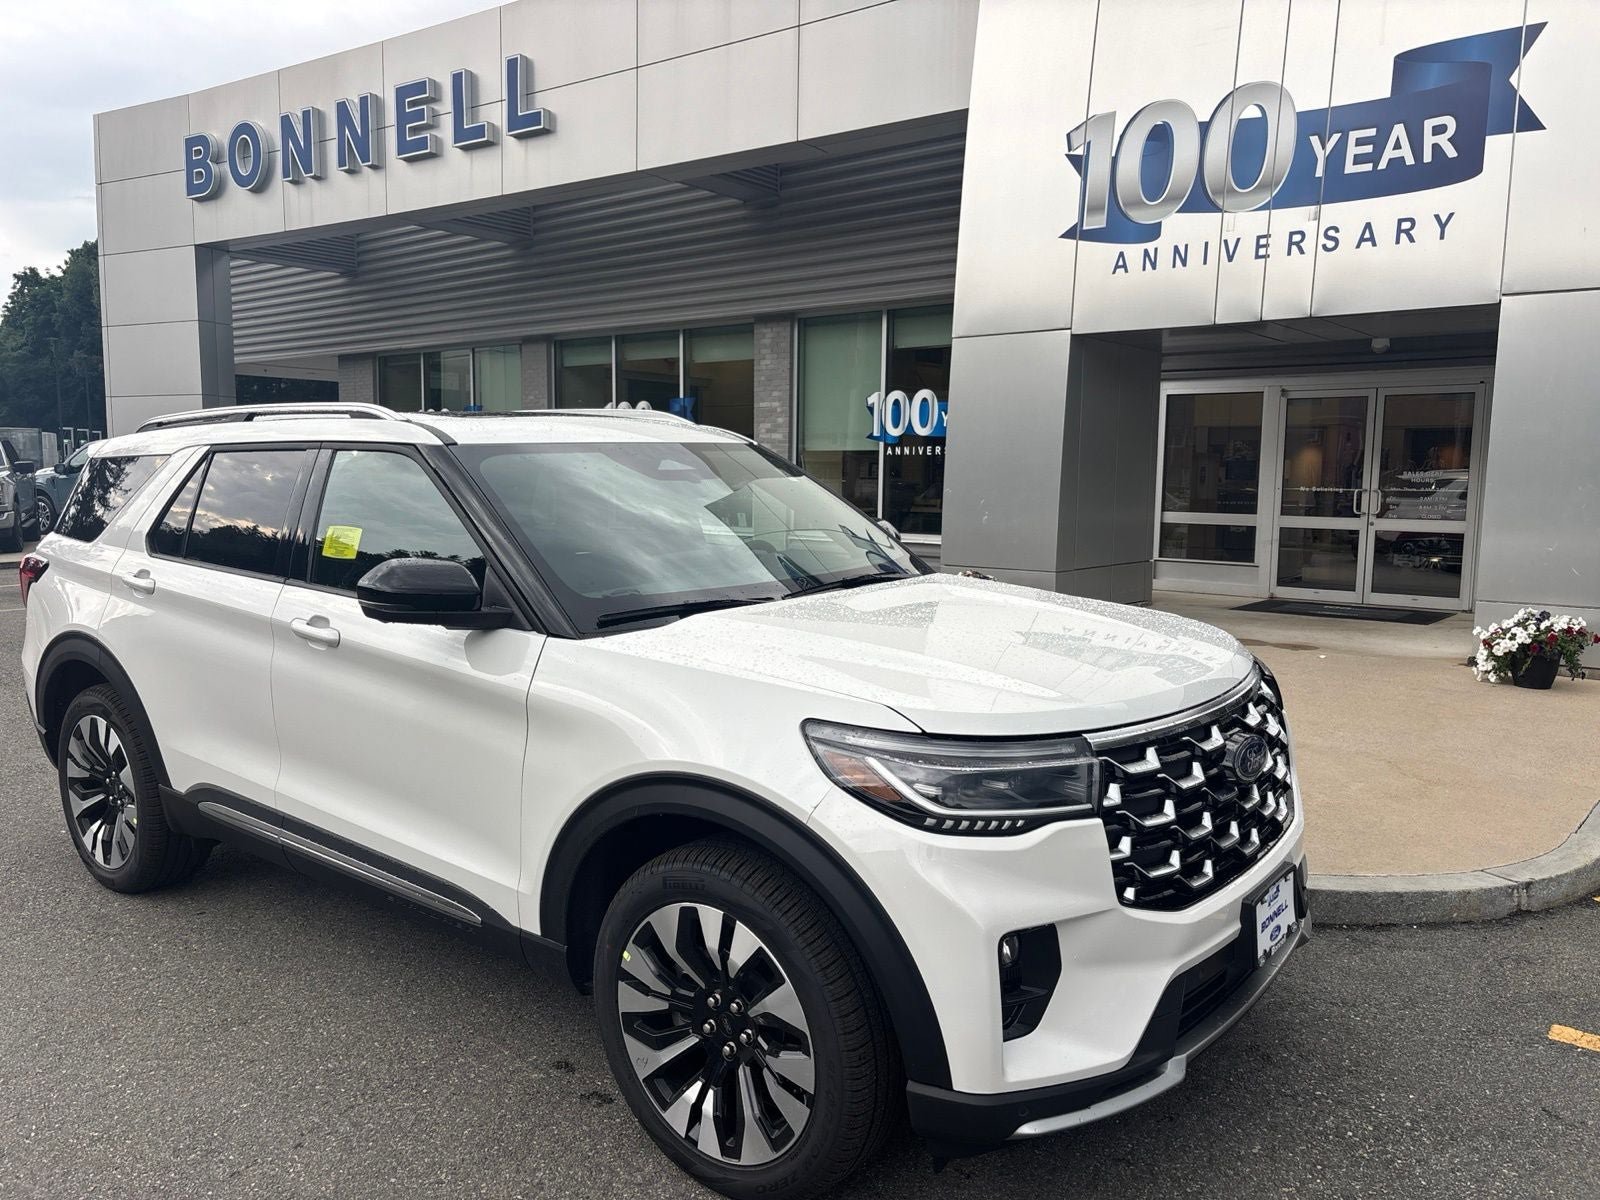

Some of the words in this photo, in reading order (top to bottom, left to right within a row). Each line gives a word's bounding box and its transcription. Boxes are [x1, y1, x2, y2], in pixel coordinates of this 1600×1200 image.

[183, 53, 550, 201] BONNELL
[1066, 80, 1297, 231] 100
[1309, 114, 1459, 178] YEAR
[1111, 211, 1456, 275] ANNIVERSARY
[866, 388, 939, 437] 100
[886, 445, 946, 456] ANNIVER
[1261, 900, 1289, 934] BONNELL
[754, 1171, 800, 1195] ZERO
